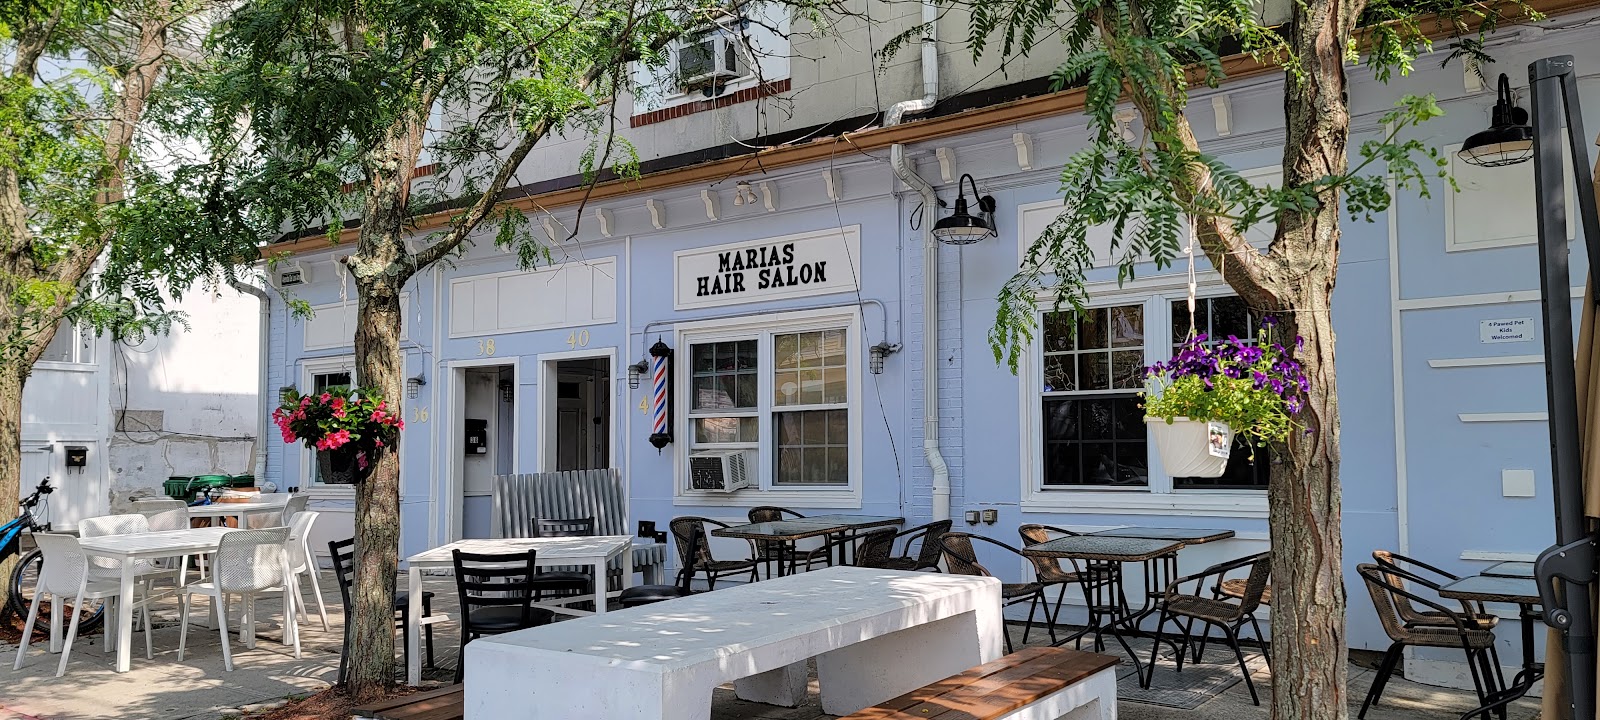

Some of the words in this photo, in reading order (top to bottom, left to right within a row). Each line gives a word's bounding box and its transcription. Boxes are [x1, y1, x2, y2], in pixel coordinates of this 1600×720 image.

[718, 243, 794, 273] MARIAS
[696, 272, 746, 296] HAIR
[758, 261, 827, 289] SALON
[476, 338, 496, 356] 38
[567, 329, 590, 350] 40
[412, 406, 429, 424] 36
